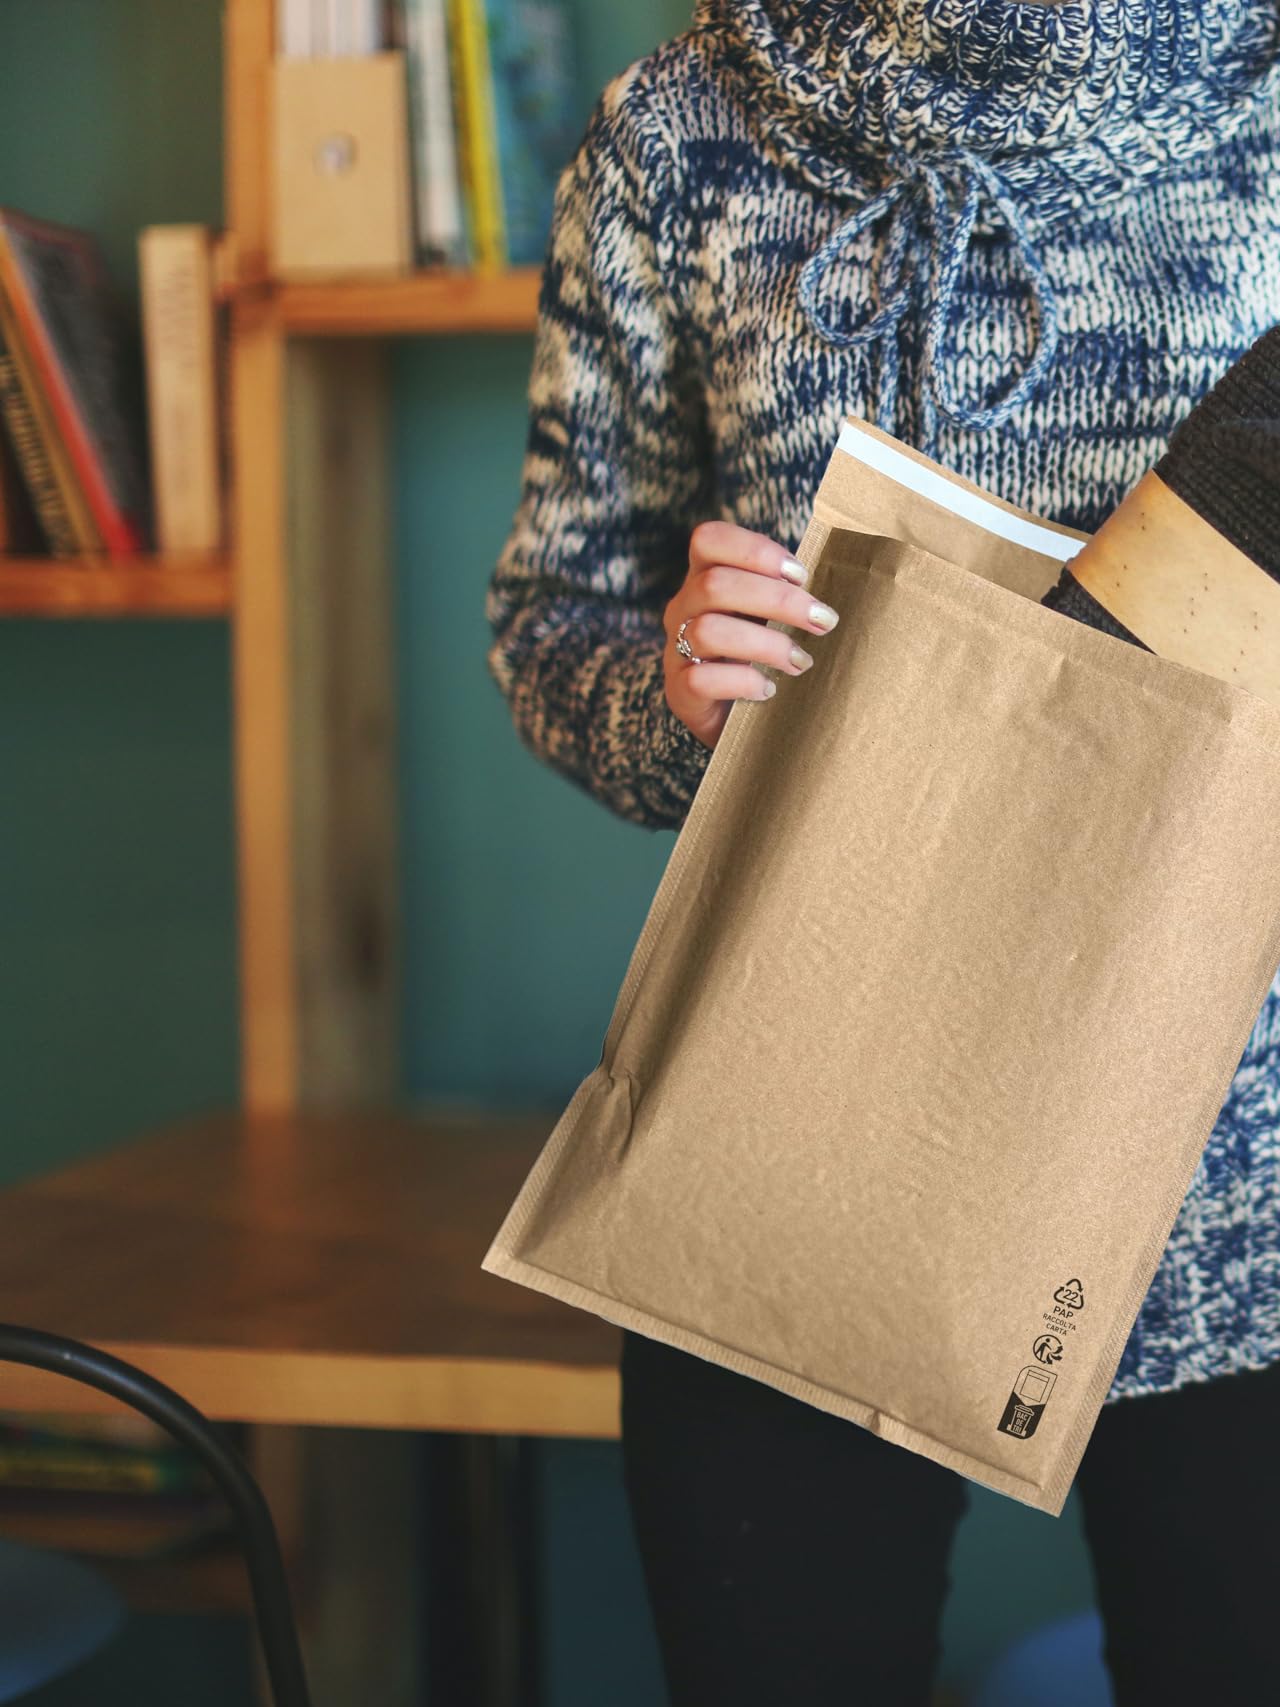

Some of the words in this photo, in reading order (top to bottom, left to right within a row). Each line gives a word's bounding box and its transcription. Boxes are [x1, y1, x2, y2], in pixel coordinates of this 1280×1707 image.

[1063, 1289, 1079, 1303] 22
[1053, 1306, 1074, 1319] PAP
[1042, 1313, 1076, 1331] RACCOLTA
[1046, 1323, 1067, 1336] CARTA
[1016, 1411, 1028, 1421] BAC
[1012, 1425, 1022, 1433] TRI
